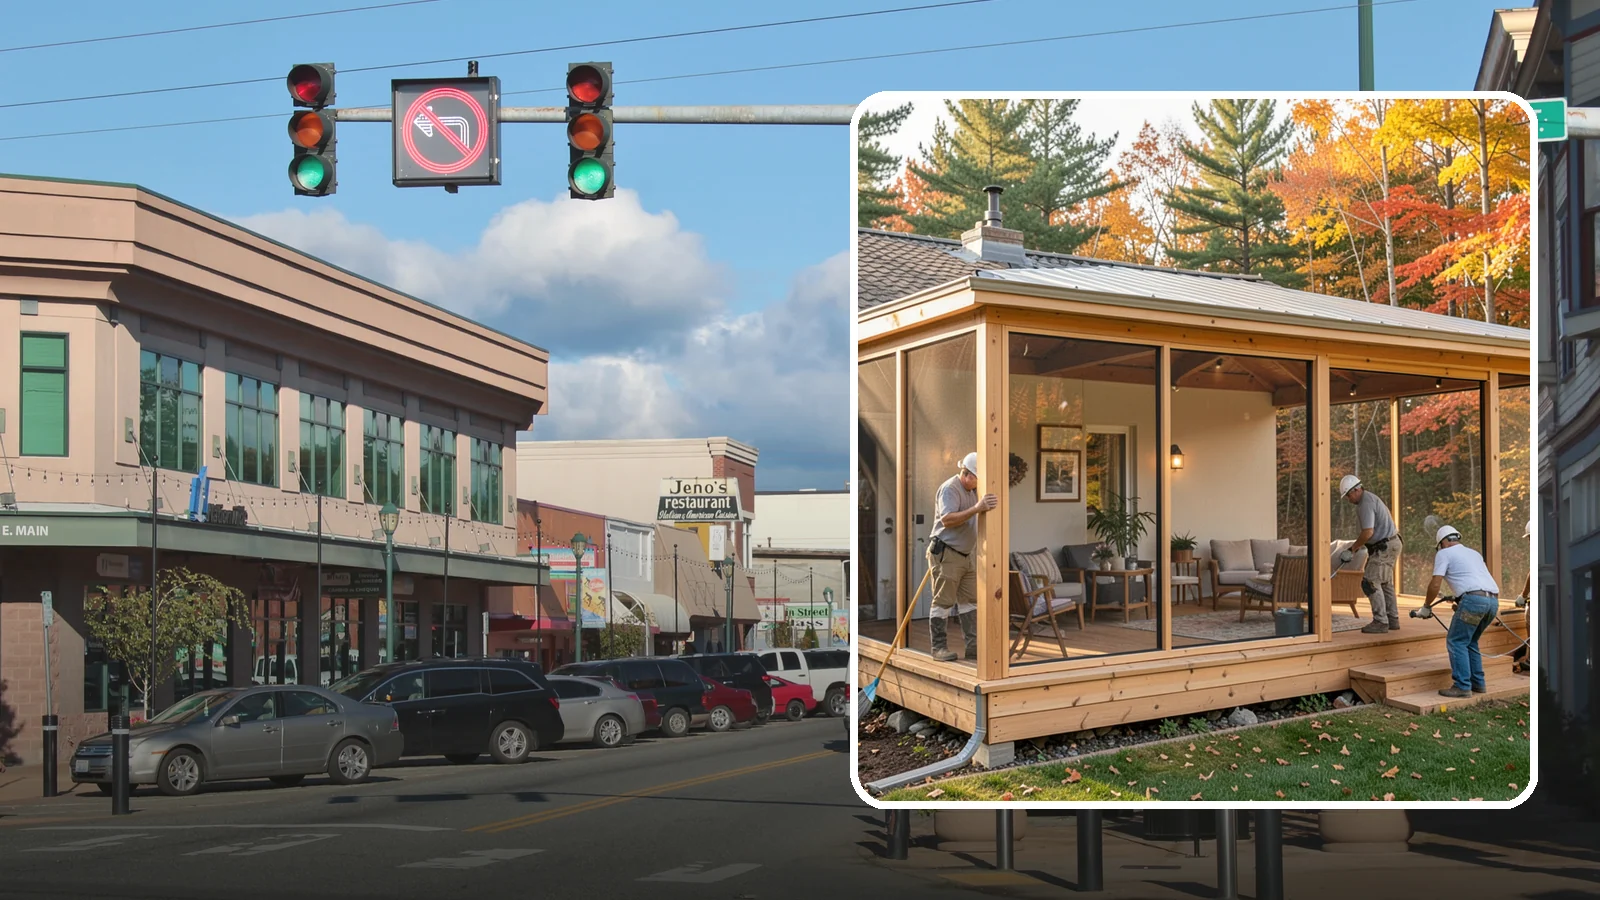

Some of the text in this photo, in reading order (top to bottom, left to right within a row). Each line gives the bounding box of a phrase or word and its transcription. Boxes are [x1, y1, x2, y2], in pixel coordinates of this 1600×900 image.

[669, 480, 728, 494] Jeno's
[665, 496, 731, 509] restaurant
[658, 510, 682, 520] Italian
[686, 510, 714, 519] American
[714, 510, 738, 519] Cuisine
[2, 525, 49, 536] E. MAIN
[797, 607, 829, 617] Street
[791, 619, 824, 627] lass
